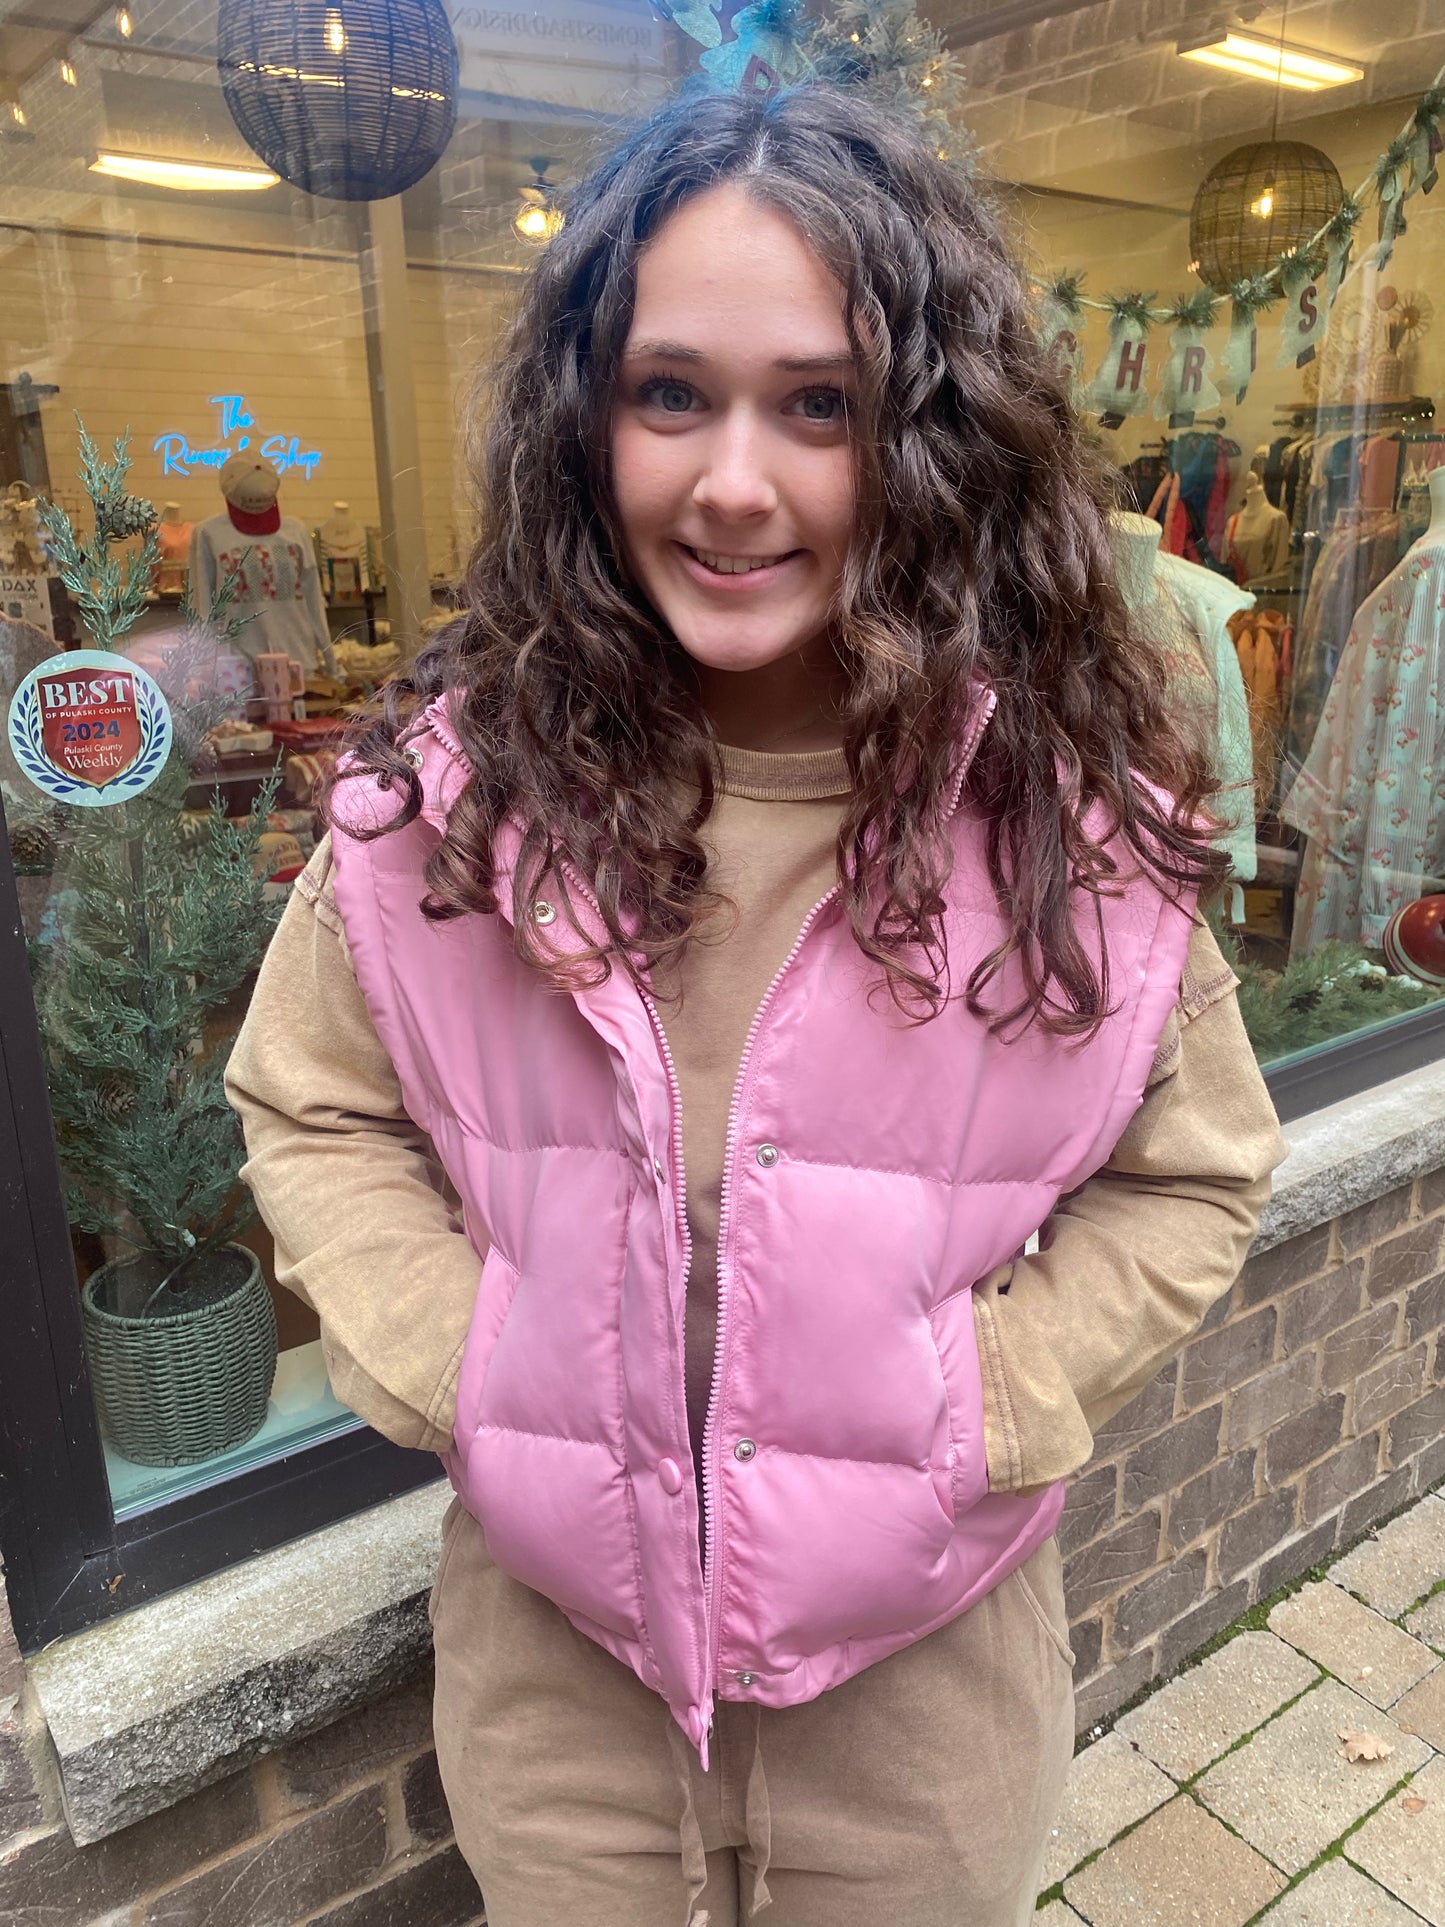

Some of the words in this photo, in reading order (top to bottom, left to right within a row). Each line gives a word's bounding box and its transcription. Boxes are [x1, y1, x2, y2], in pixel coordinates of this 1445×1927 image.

[211, 395, 255, 439] The
[260, 435, 322, 481] Shop
[43, 679, 129, 708] BEST
[60, 710, 96, 718] PULASKI
[62, 720, 120, 741] 2024
[64, 745, 92, 755] Pulaski
[94, 743, 123, 752] County
[66, 753, 122, 769] Weekly
